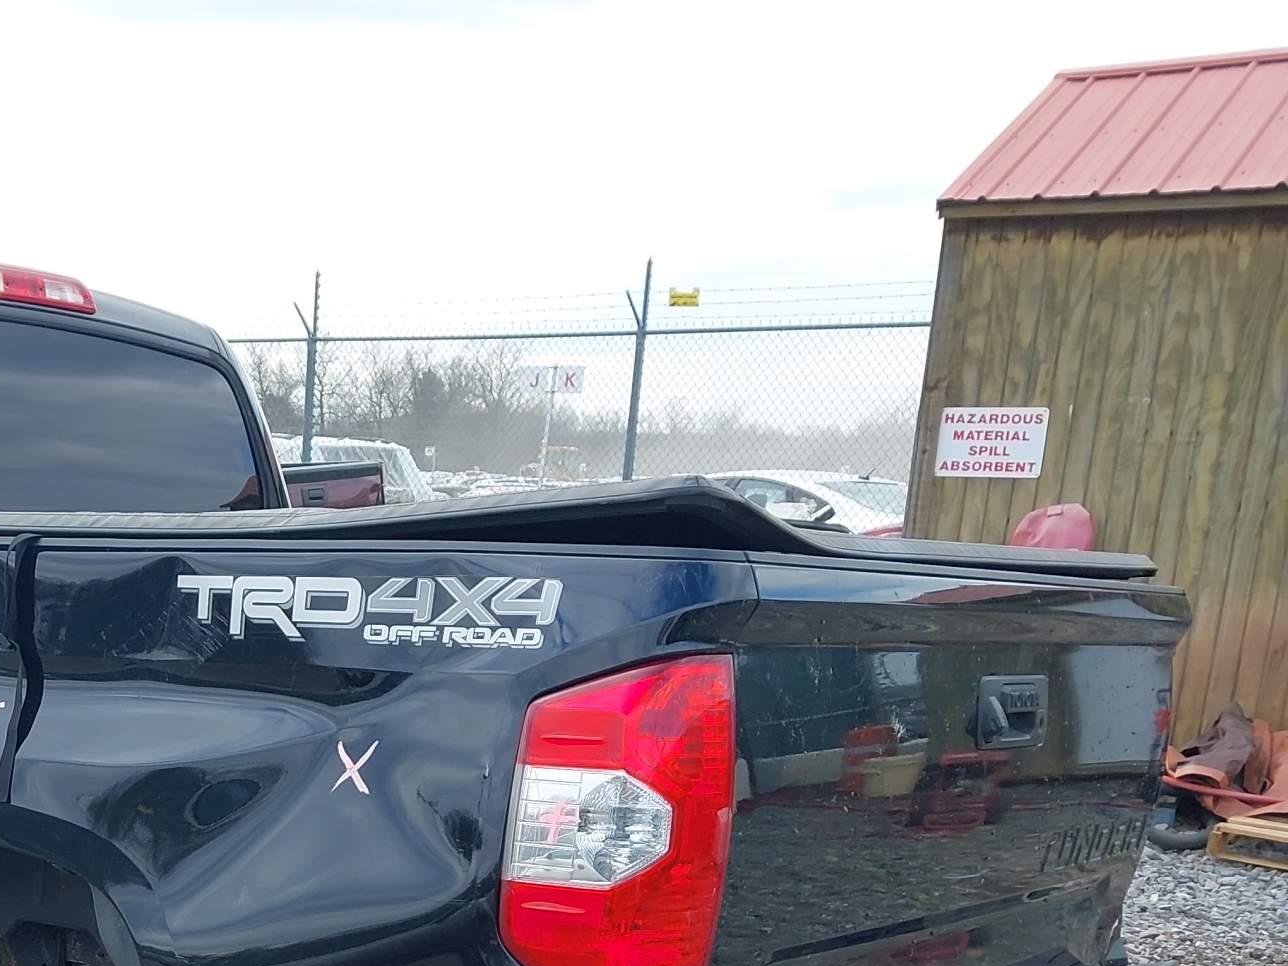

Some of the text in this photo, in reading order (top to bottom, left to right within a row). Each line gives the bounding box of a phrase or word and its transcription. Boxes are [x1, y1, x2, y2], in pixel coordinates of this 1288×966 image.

[529, 372, 540, 388] J
[564, 371, 577, 388] K
[944, 413, 1045, 425] HAZARDOUS
[952, 430, 1031, 442] MATERIAL
[967, 445, 1011, 457] SPILL
[939, 460, 1037, 473] ABSORBENT
[176, 574, 366, 643] TRD
[363, 624, 545, 649] OFF ROAD
